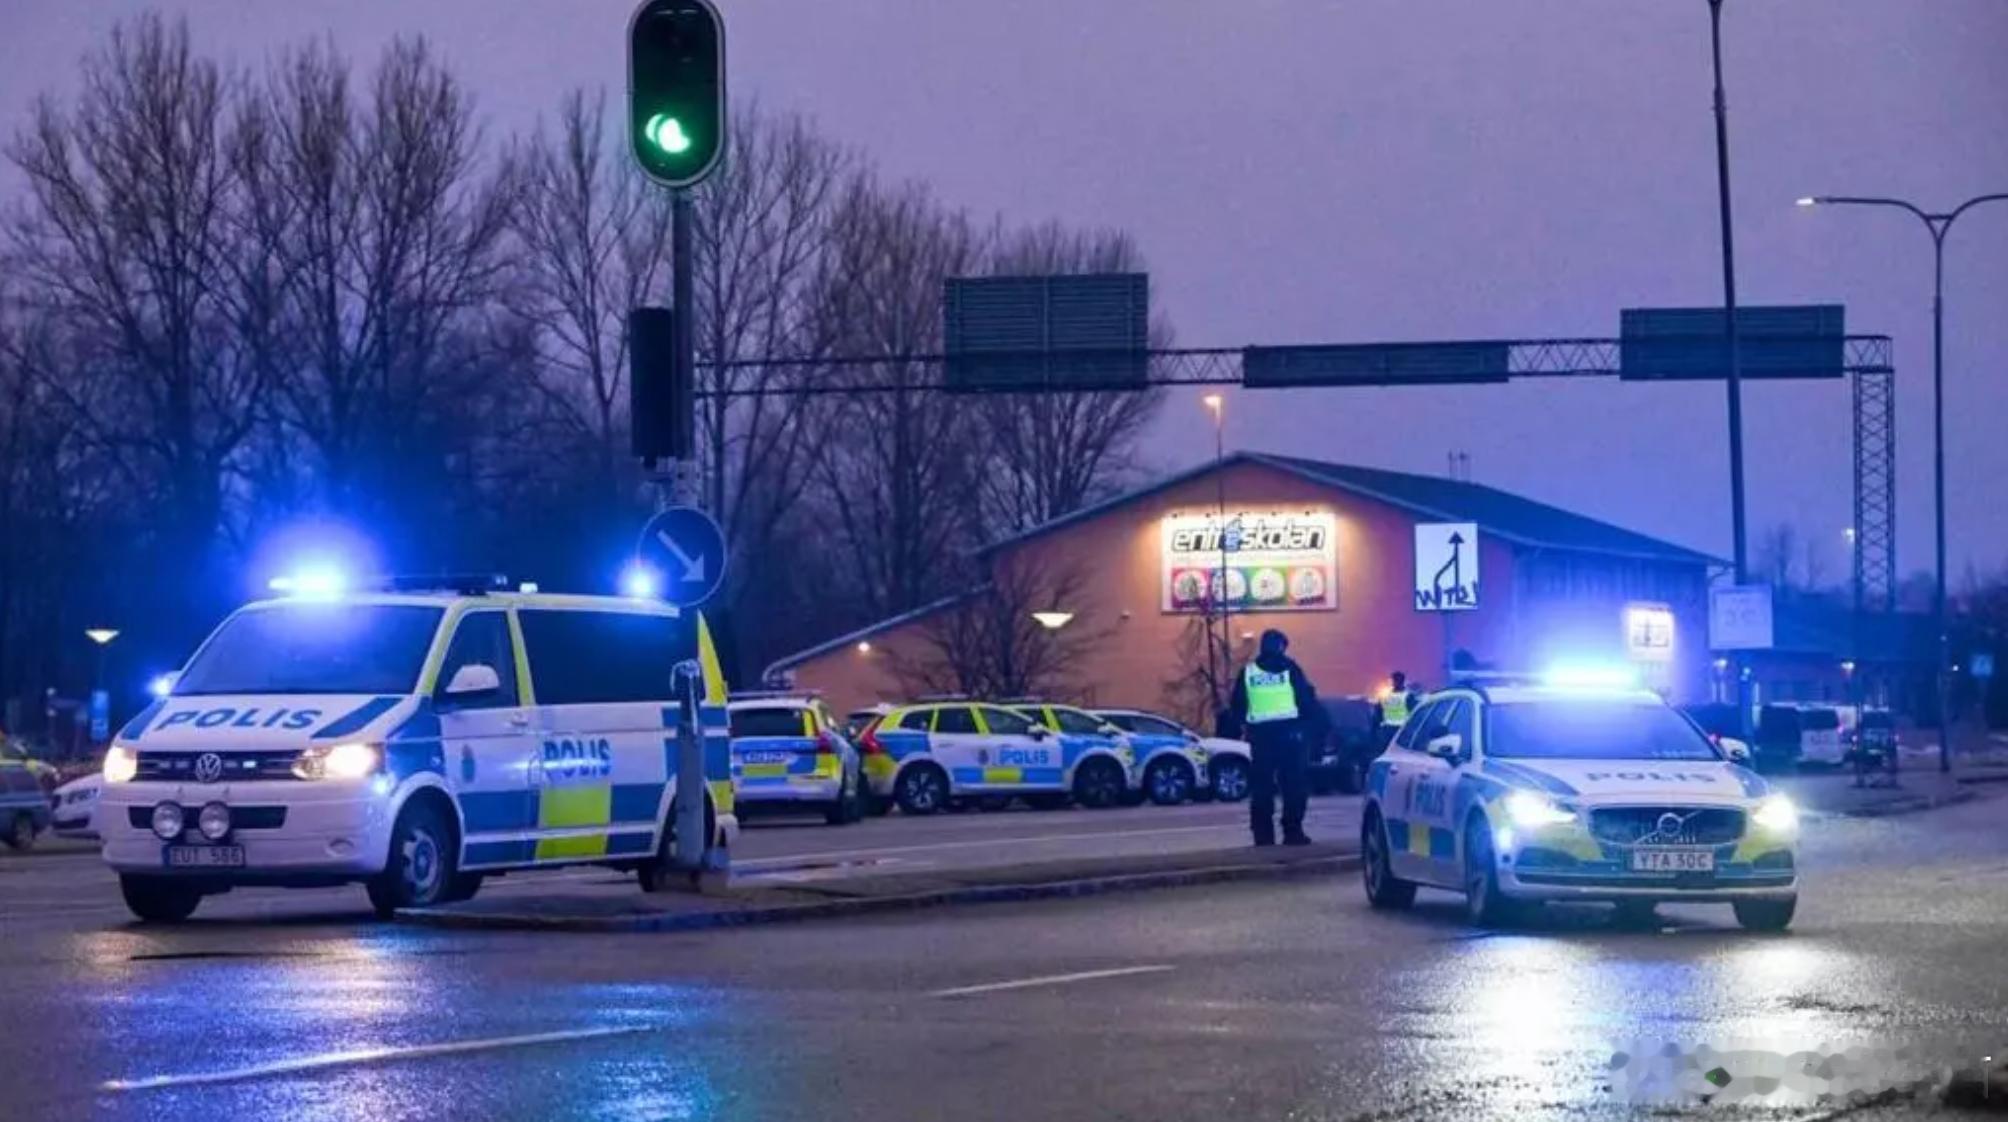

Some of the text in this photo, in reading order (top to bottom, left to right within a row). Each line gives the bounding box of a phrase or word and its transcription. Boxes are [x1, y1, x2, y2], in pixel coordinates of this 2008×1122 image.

[153, 708, 323, 731] POLIS
[543, 739, 611, 778] POLIS
[1000, 750, 1049, 765] POLIS
[1587, 772, 1716, 782] POLIS
